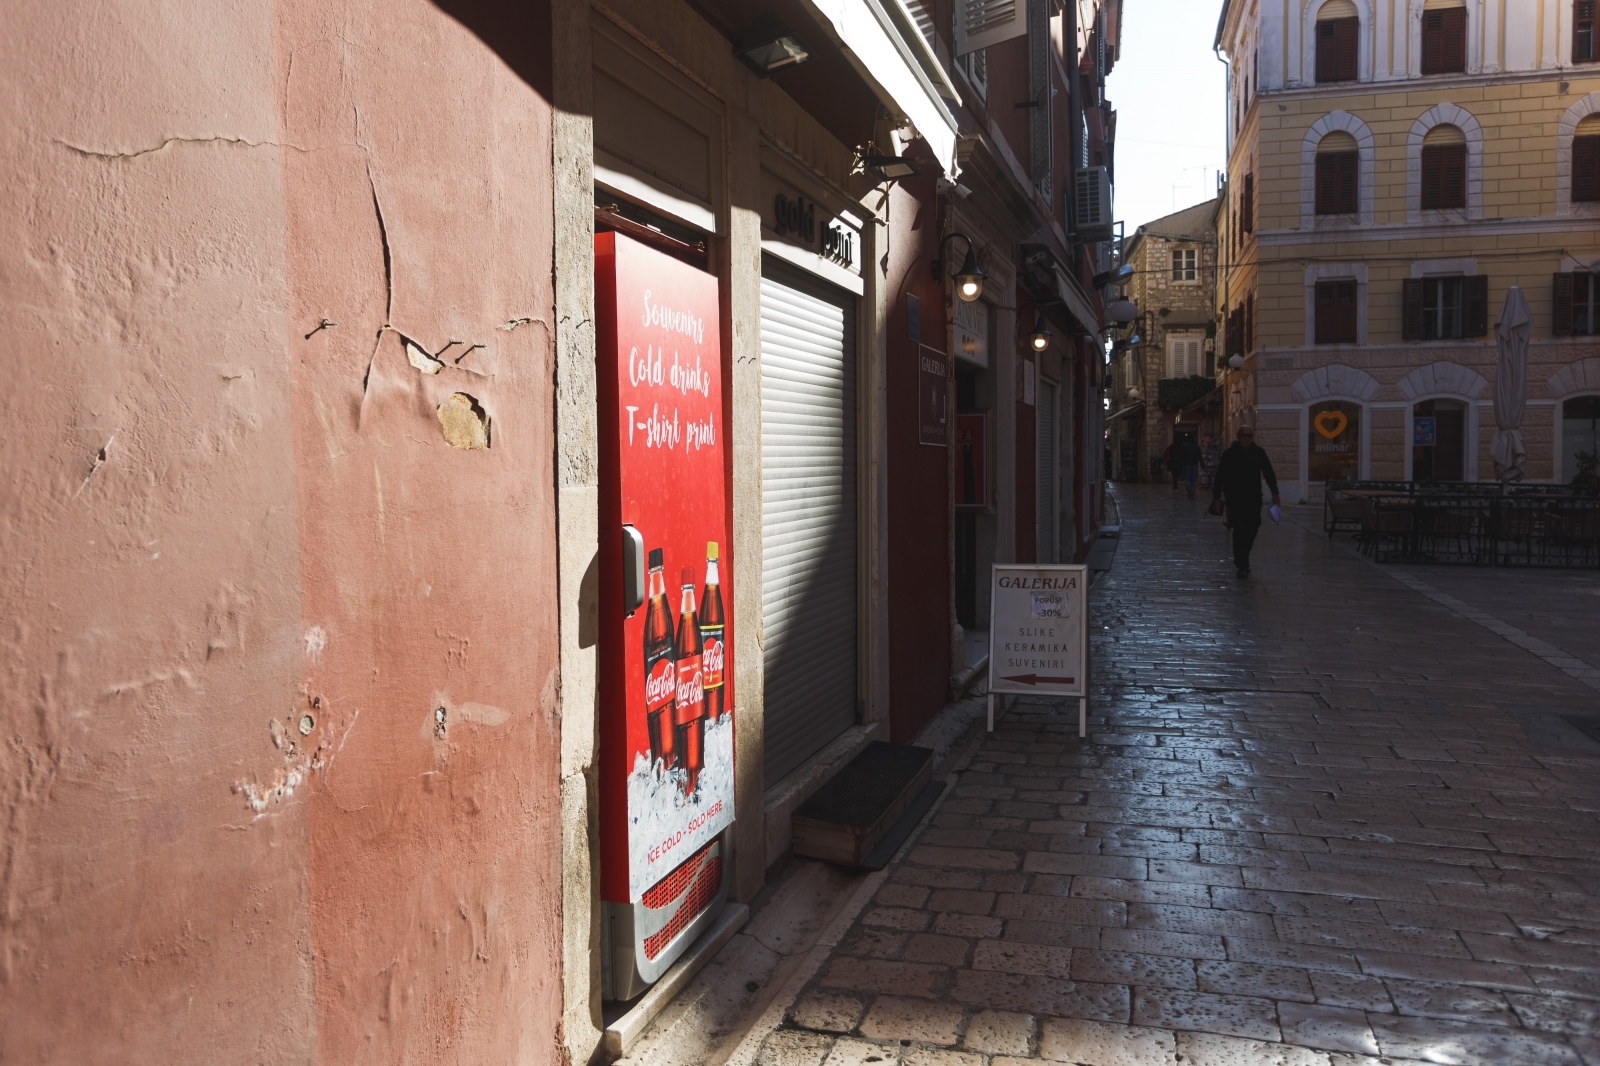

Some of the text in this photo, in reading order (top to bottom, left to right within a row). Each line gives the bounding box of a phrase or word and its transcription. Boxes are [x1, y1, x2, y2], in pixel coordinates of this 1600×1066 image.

[775, 193, 852, 263] gold point
[643, 289, 705, 345] Souvenirs
[629, 343, 711, 398] Cold drinks
[921, 356, 945, 377] GALERIJA
[625, 402, 716, 455] T-shirt print
[1315, 442, 1350, 452] mlinar
[998, 576, 1077, 589] GALERIJA
[1037, 609, 1061, 618] -30%
[1019, 628, 1055, 637] SLIKE
[1005, 643, 1068, 653] KERAMIKA
[1008, 658, 1064, 669] SUVENIRI
[647, 846, 660, 865] ICE
[661, 831, 682, 854] COLD
[687, 813, 706, 834] SOLD
[706, 799, 723, 820] HERE
